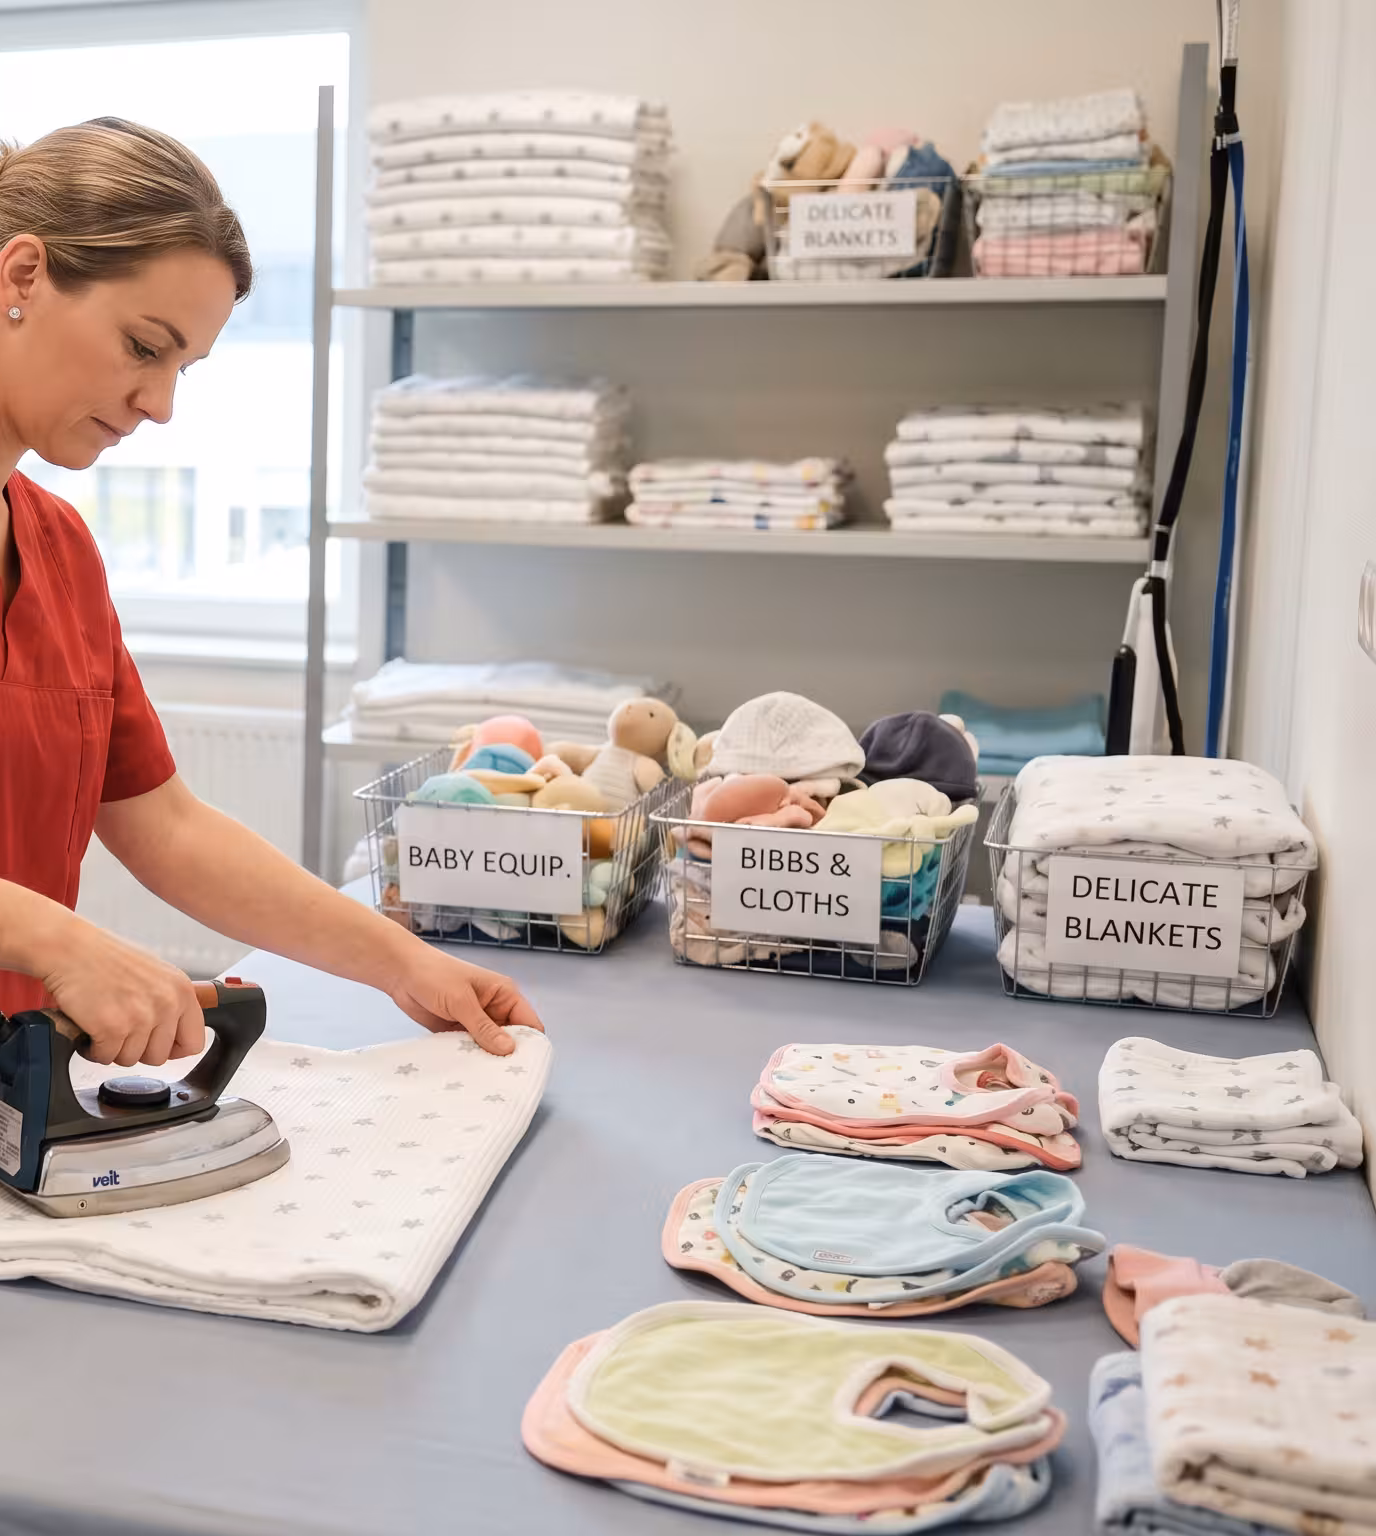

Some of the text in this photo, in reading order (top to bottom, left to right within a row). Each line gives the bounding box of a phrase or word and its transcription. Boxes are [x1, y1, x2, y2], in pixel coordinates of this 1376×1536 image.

[807, 202, 894, 222] DELICATE
[804, 229, 897, 249] BLANKETS
[408, 845, 572, 879] BABY EQUIP.
[741, 847, 852, 878] BIBBS &
[739, 887, 850, 917] CLOTHS
[1072, 875, 1219, 909] DELICATE
[1064, 916, 1223, 951] BLANKETS
[92, 1169, 120, 1188] veit
